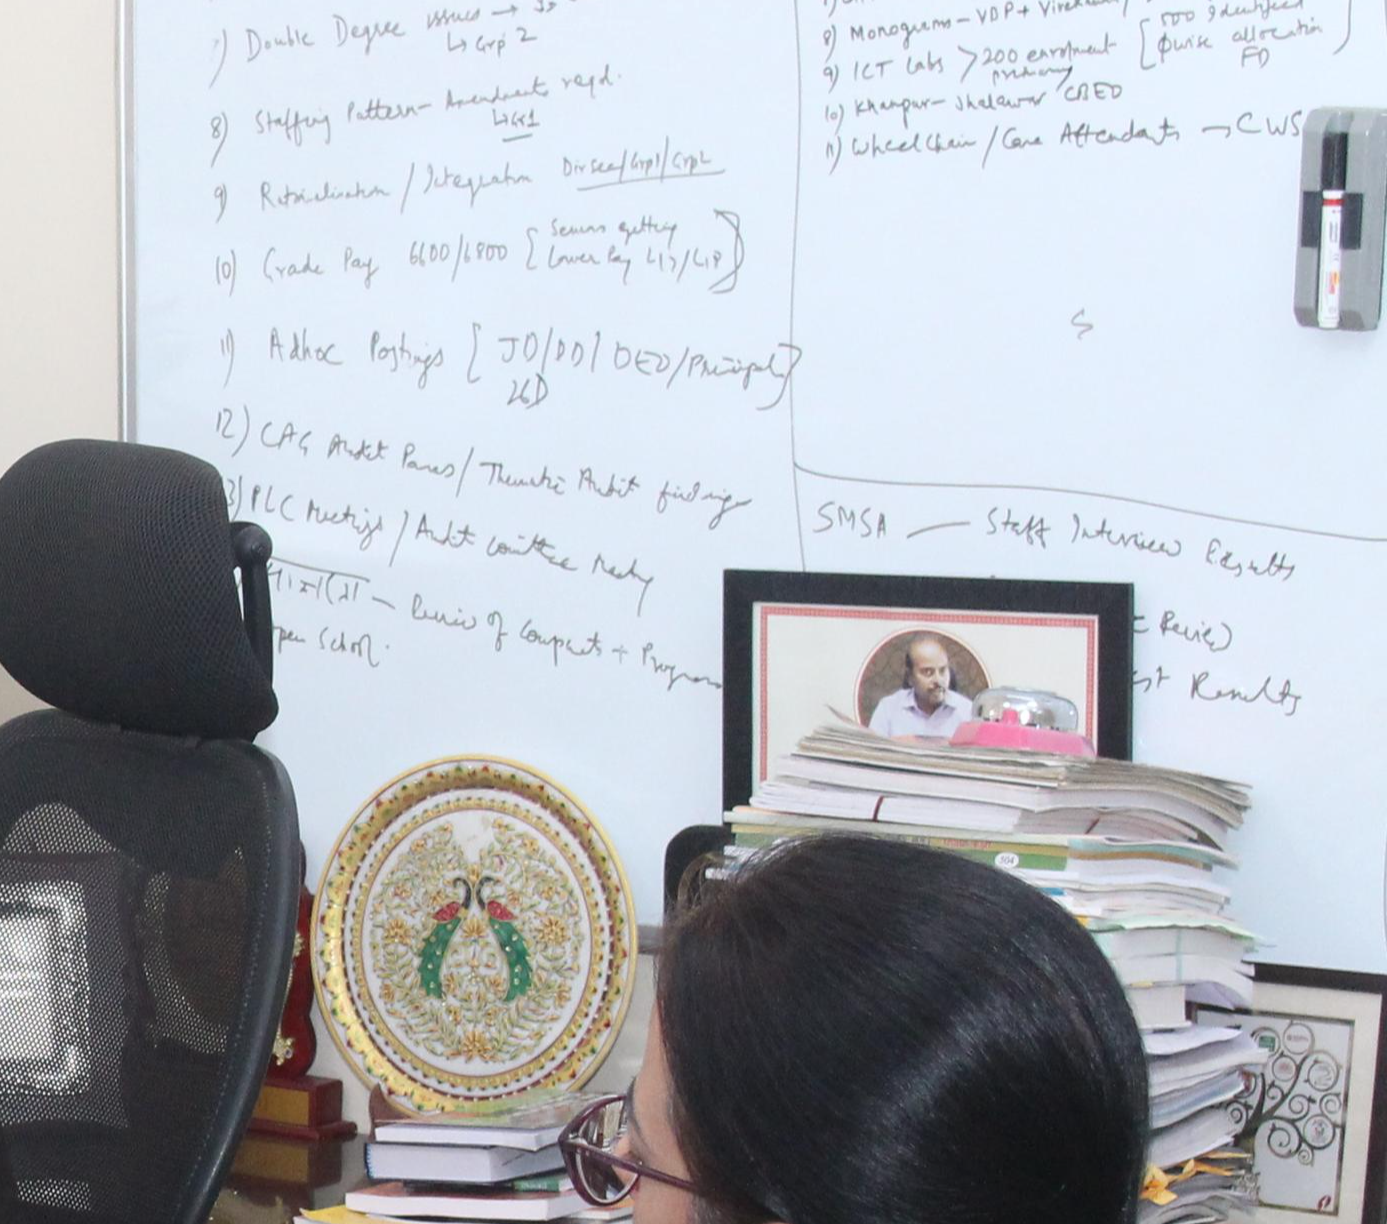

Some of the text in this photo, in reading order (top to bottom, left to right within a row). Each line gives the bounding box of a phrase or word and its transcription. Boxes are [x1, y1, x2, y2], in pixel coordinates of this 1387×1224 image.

[247, 26, 315, 62] Double
[333, 14, 405, 54] Degree
[1231, 17, 1323, 43] allocation
[853, 60, 894, 81] ICT
[906, 51, 945, 75] Labs
[982, 48, 1019, 65] 200
[255, 107, 331, 147] Staffing
[263, 246, 325, 283] Grade
[344, 246, 379, 290] Pay
[270, 326, 344, 366] Adhoc
[812, 501, 888, 540] SMSA
[985, 507, 1051, 548] Staff
[1071, 512, 1182, 559] Interview
